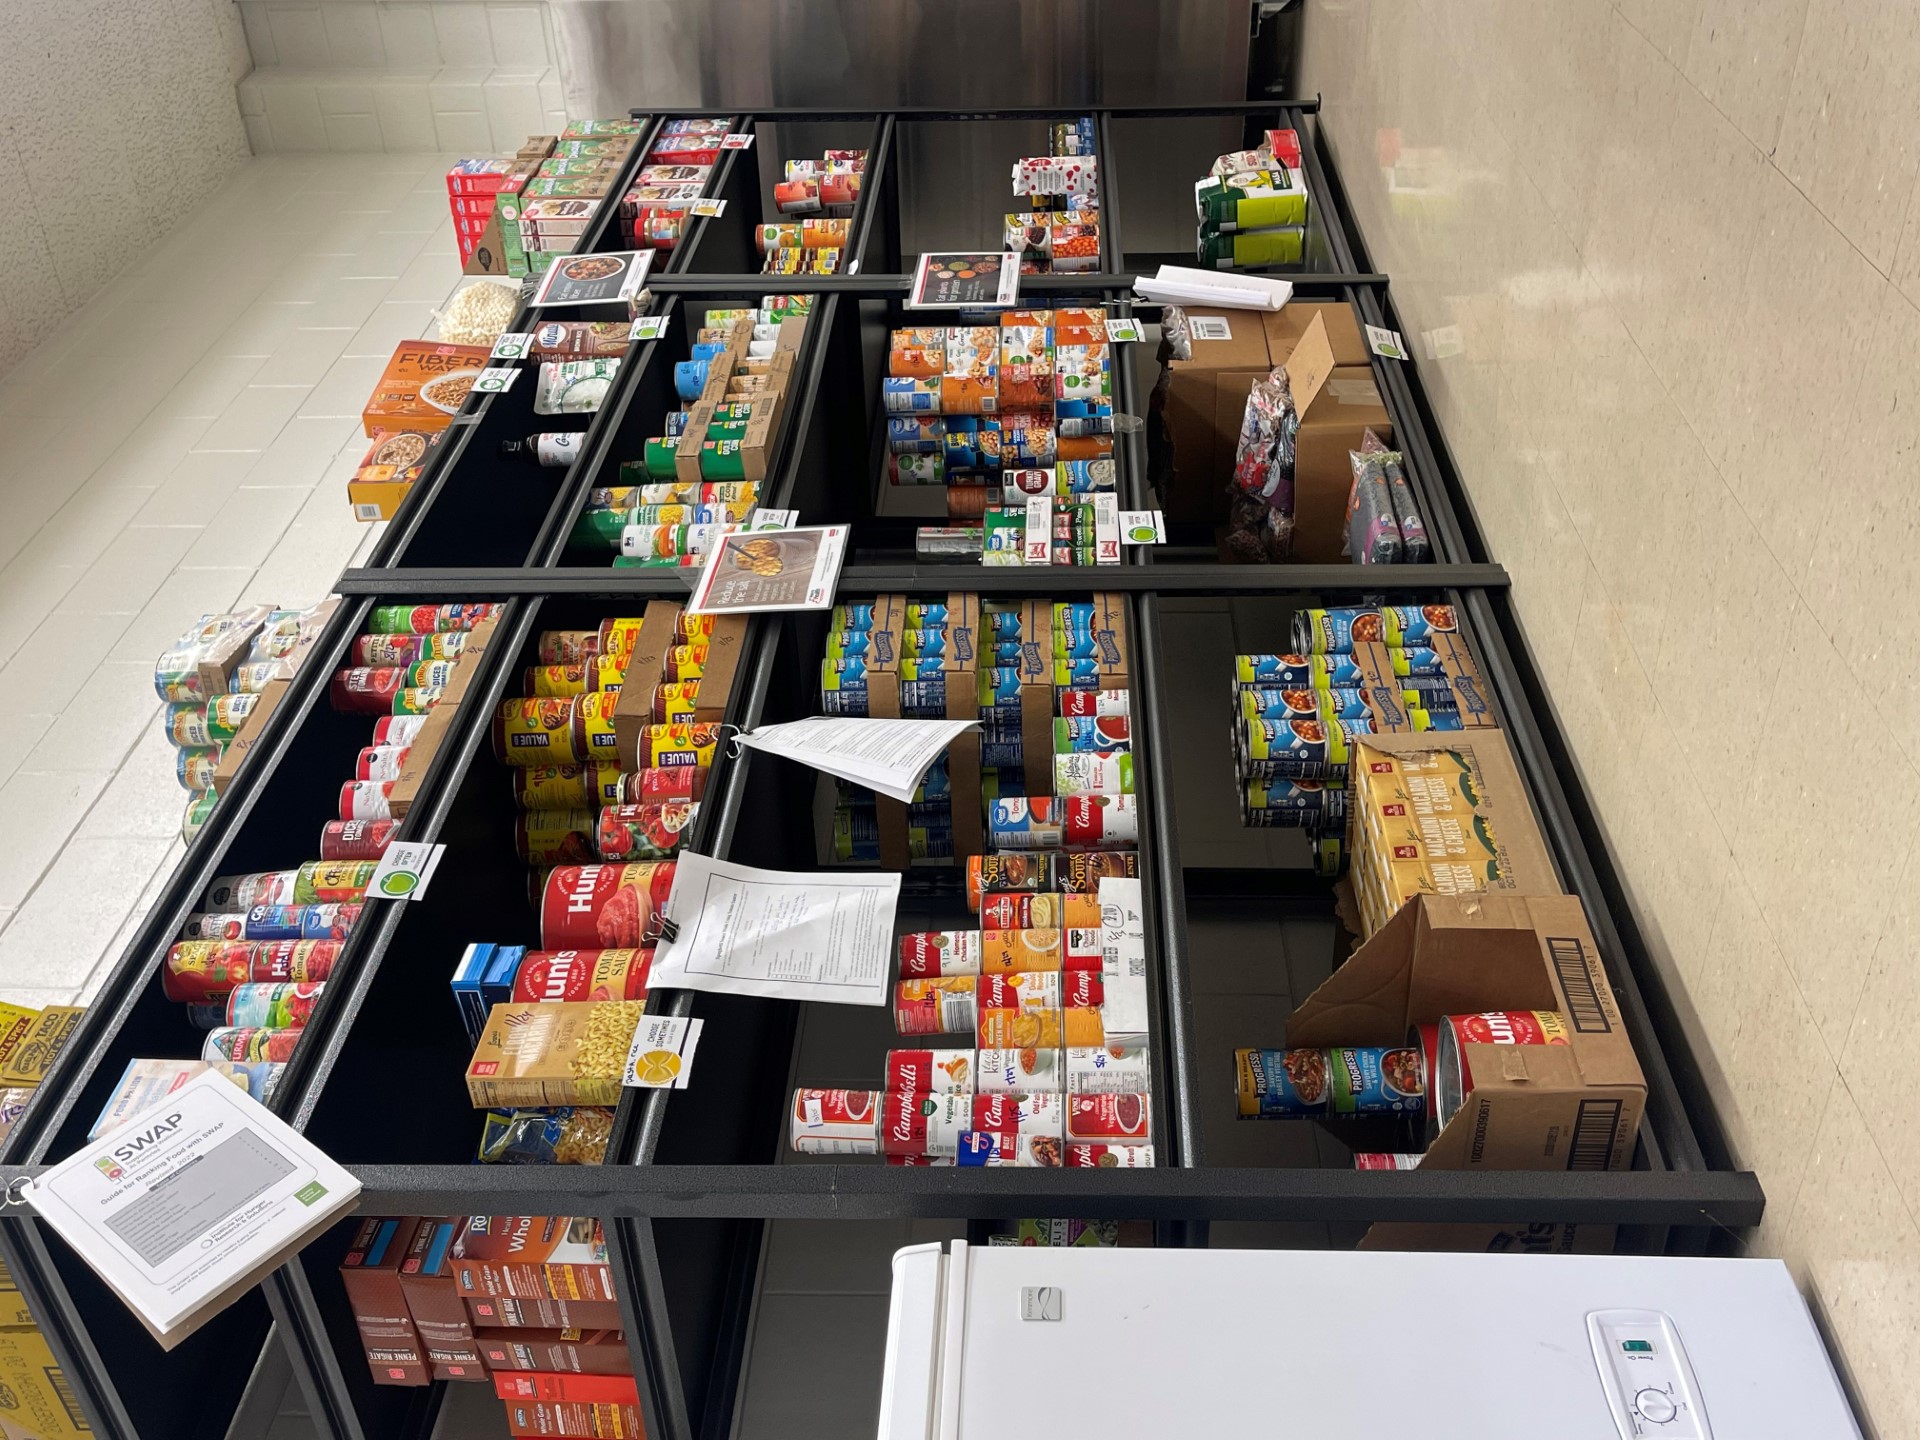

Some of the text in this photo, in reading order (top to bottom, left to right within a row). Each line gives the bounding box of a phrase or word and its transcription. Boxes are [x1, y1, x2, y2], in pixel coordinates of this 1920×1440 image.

[1271, 171, 1281, 185] MASA
[935, 281, 949, 302] Eat plants
[948, 279, 961, 302] for protein
[572, 329, 583, 352] BROWN RICE
[398, 352, 484, 368] FIBER
[1024, 470, 1034, 490] TURKEY
[1033, 470, 1042, 488] GRAVY
[1076, 526, 1084, 546] Sweet
[716, 580, 734, 605] Reduce
[732, 580, 750, 604] the salt
[955, 629, 973, 659] PROGRESSO
[1322, 616, 1336, 651] PROGRESSO
[875, 632, 893, 661] PROGRESSO
[1023, 643, 1043, 672] PROGRESSO
[1097, 632, 1120, 662] PROGRESSO
[432, 666, 442, 686] DICED
[1373, 689, 1402, 723] PROGRESSO
[1457, 677, 1486, 711] PROGRESSO
[519, 734, 549, 746] VALUE
[666, 751, 697, 765] VALUE
[1406, 775, 1434, 814] MACARONI
[1425, 777, 1450, 803] CHEESE
[1418, 816, 1448, 857] MACARONI
[1438, 818, 1465, 845] CHEESE
[970, 870, 989, 894] Amy's
[1068, 853, 1086, 889] SOUPS
[1505, 875, 1518, 889] OCT
[1001, 896, 1010, 928] Little Chef
[1021, 910, 1029, 928] Chicken
[960, 940, 968, 963] Chicken
[1586, 954, 1601, 978] 39061
[524, 975, 538, 998] PROUDLY
[1049, 974, 1057, 987] SOUP
[35, 1013, 59, 1038] TACO
[646, 1023, 660, 1043] CHOOSE
[655, 1020, 670, 1048] SOMETIMES
[43, 1019, 76, 1065] HOT SPICY
[501, 1026, 525, 1056] ELBOW
[519, 1014, 553, 1064] MACARONI
[1249, 1052, 1267, 1094] PROGRESSO
[1267, 1056, 1276, 1088] SAVORY BEEF
[1343, 1050, 1363, 1091] PROGRESSO
[1362, 1051, 1373, 1090] SAVORY CHICKEN
[1370, 1065, 1378, 1079] WILD
[1275, 1075, 1284, 1096] BARLEY
[113, 1099, 130, 1117] FOOD
[962, 1101, 970, 1118] SOUP
[1033, 1103, 1041, 1114] Old
[1106, 1100, 1116, 1129] Vegetable
[114, 1113, 183, 1162] SWAP
[1002, 1136, 1011, 1150] BEEF
[100, 1122, 224, 1205] Guide for Ranking Food with SWAP
[413, 1237, 428, 1253] PENNE
[508, 1216, 533, 1252] Whol
[483, 1265, 497, 1295] Whole Grain
[1025, 1288, 1034, 1318] Kenmore
[505, 1312, 521, 1326] PENNE
[368, 1351, 418, 1361] PENNE RIGATE
[428, 1351, 478, 1361] PENNE RIGATE
[535, 1403, 549, 1434] Whole Grain
